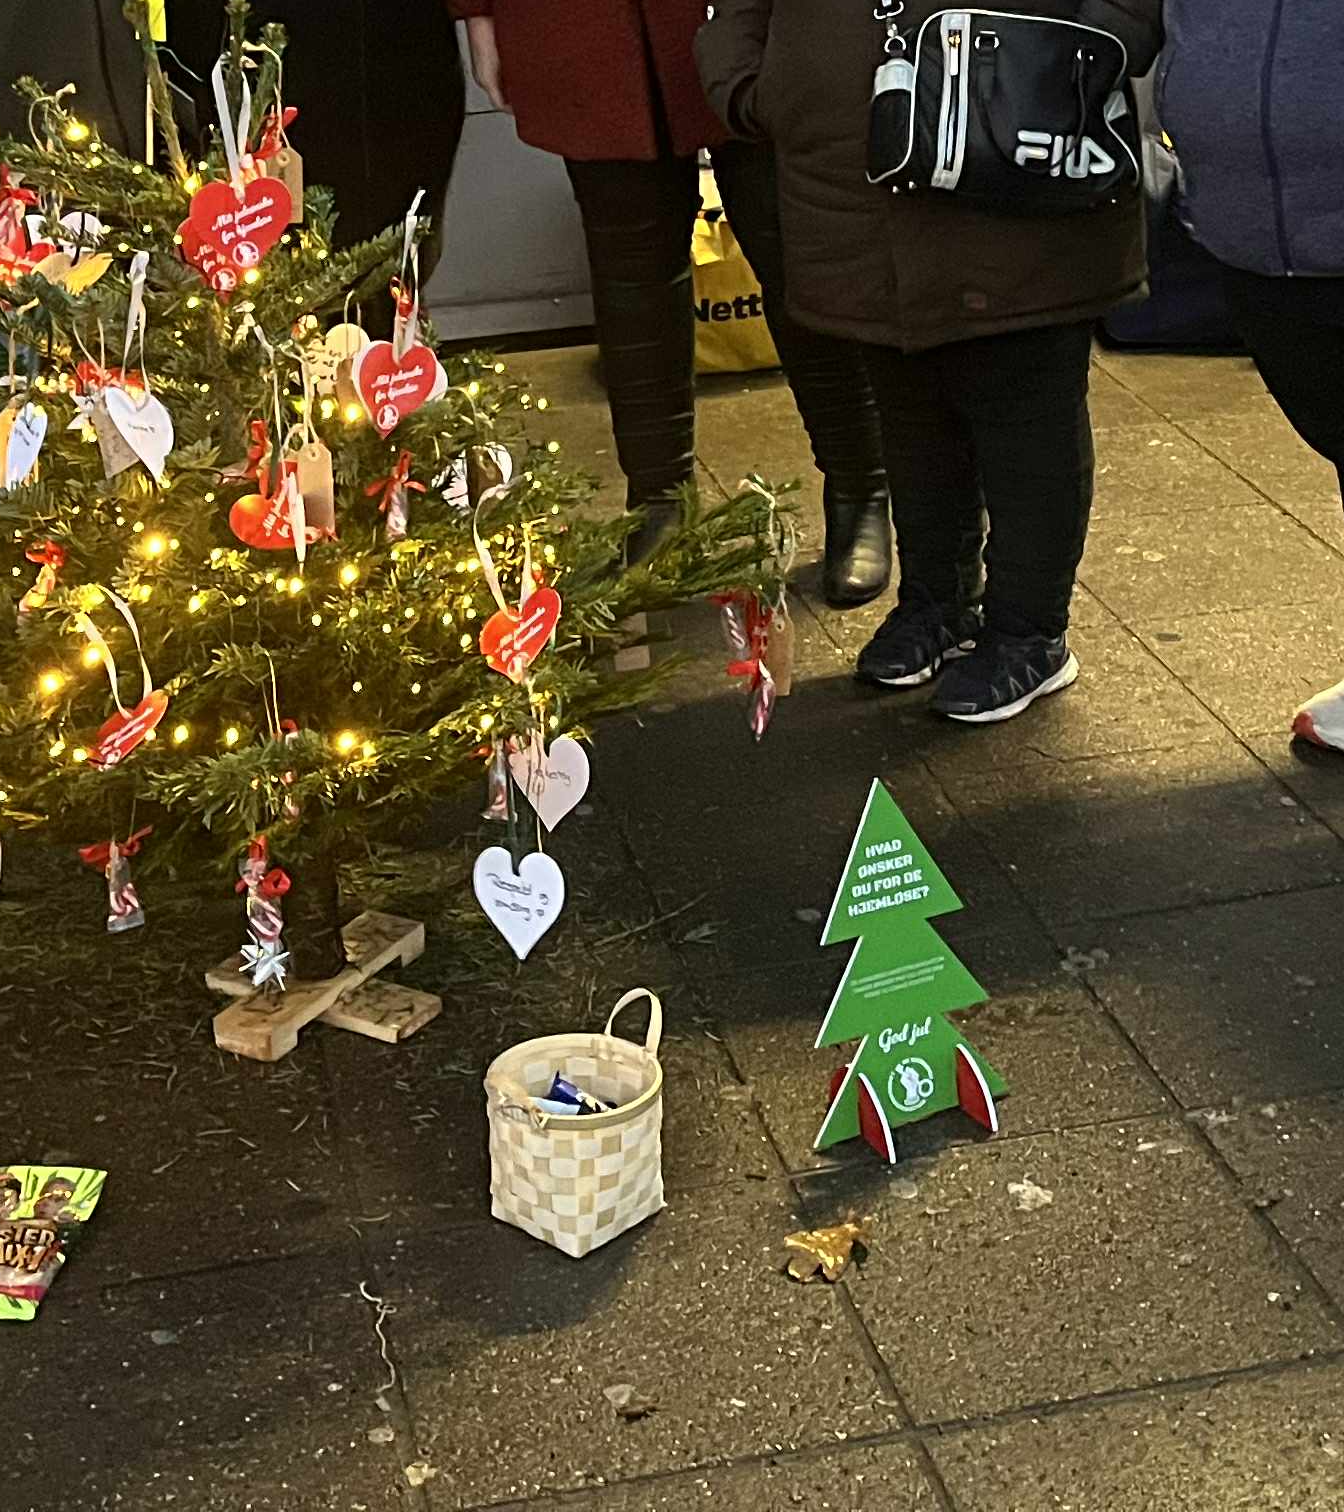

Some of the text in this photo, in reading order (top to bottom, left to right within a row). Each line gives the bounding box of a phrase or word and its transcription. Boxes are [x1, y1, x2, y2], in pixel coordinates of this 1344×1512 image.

[1015, 129, 1116, 179] FILA
[865, 839, 902, 858] HVAD
[857, 854, 913, 879] ØNSKER
[851, 869, 922, 897] DU FOR DE
[878, 1016, 932, 1053] God jul
